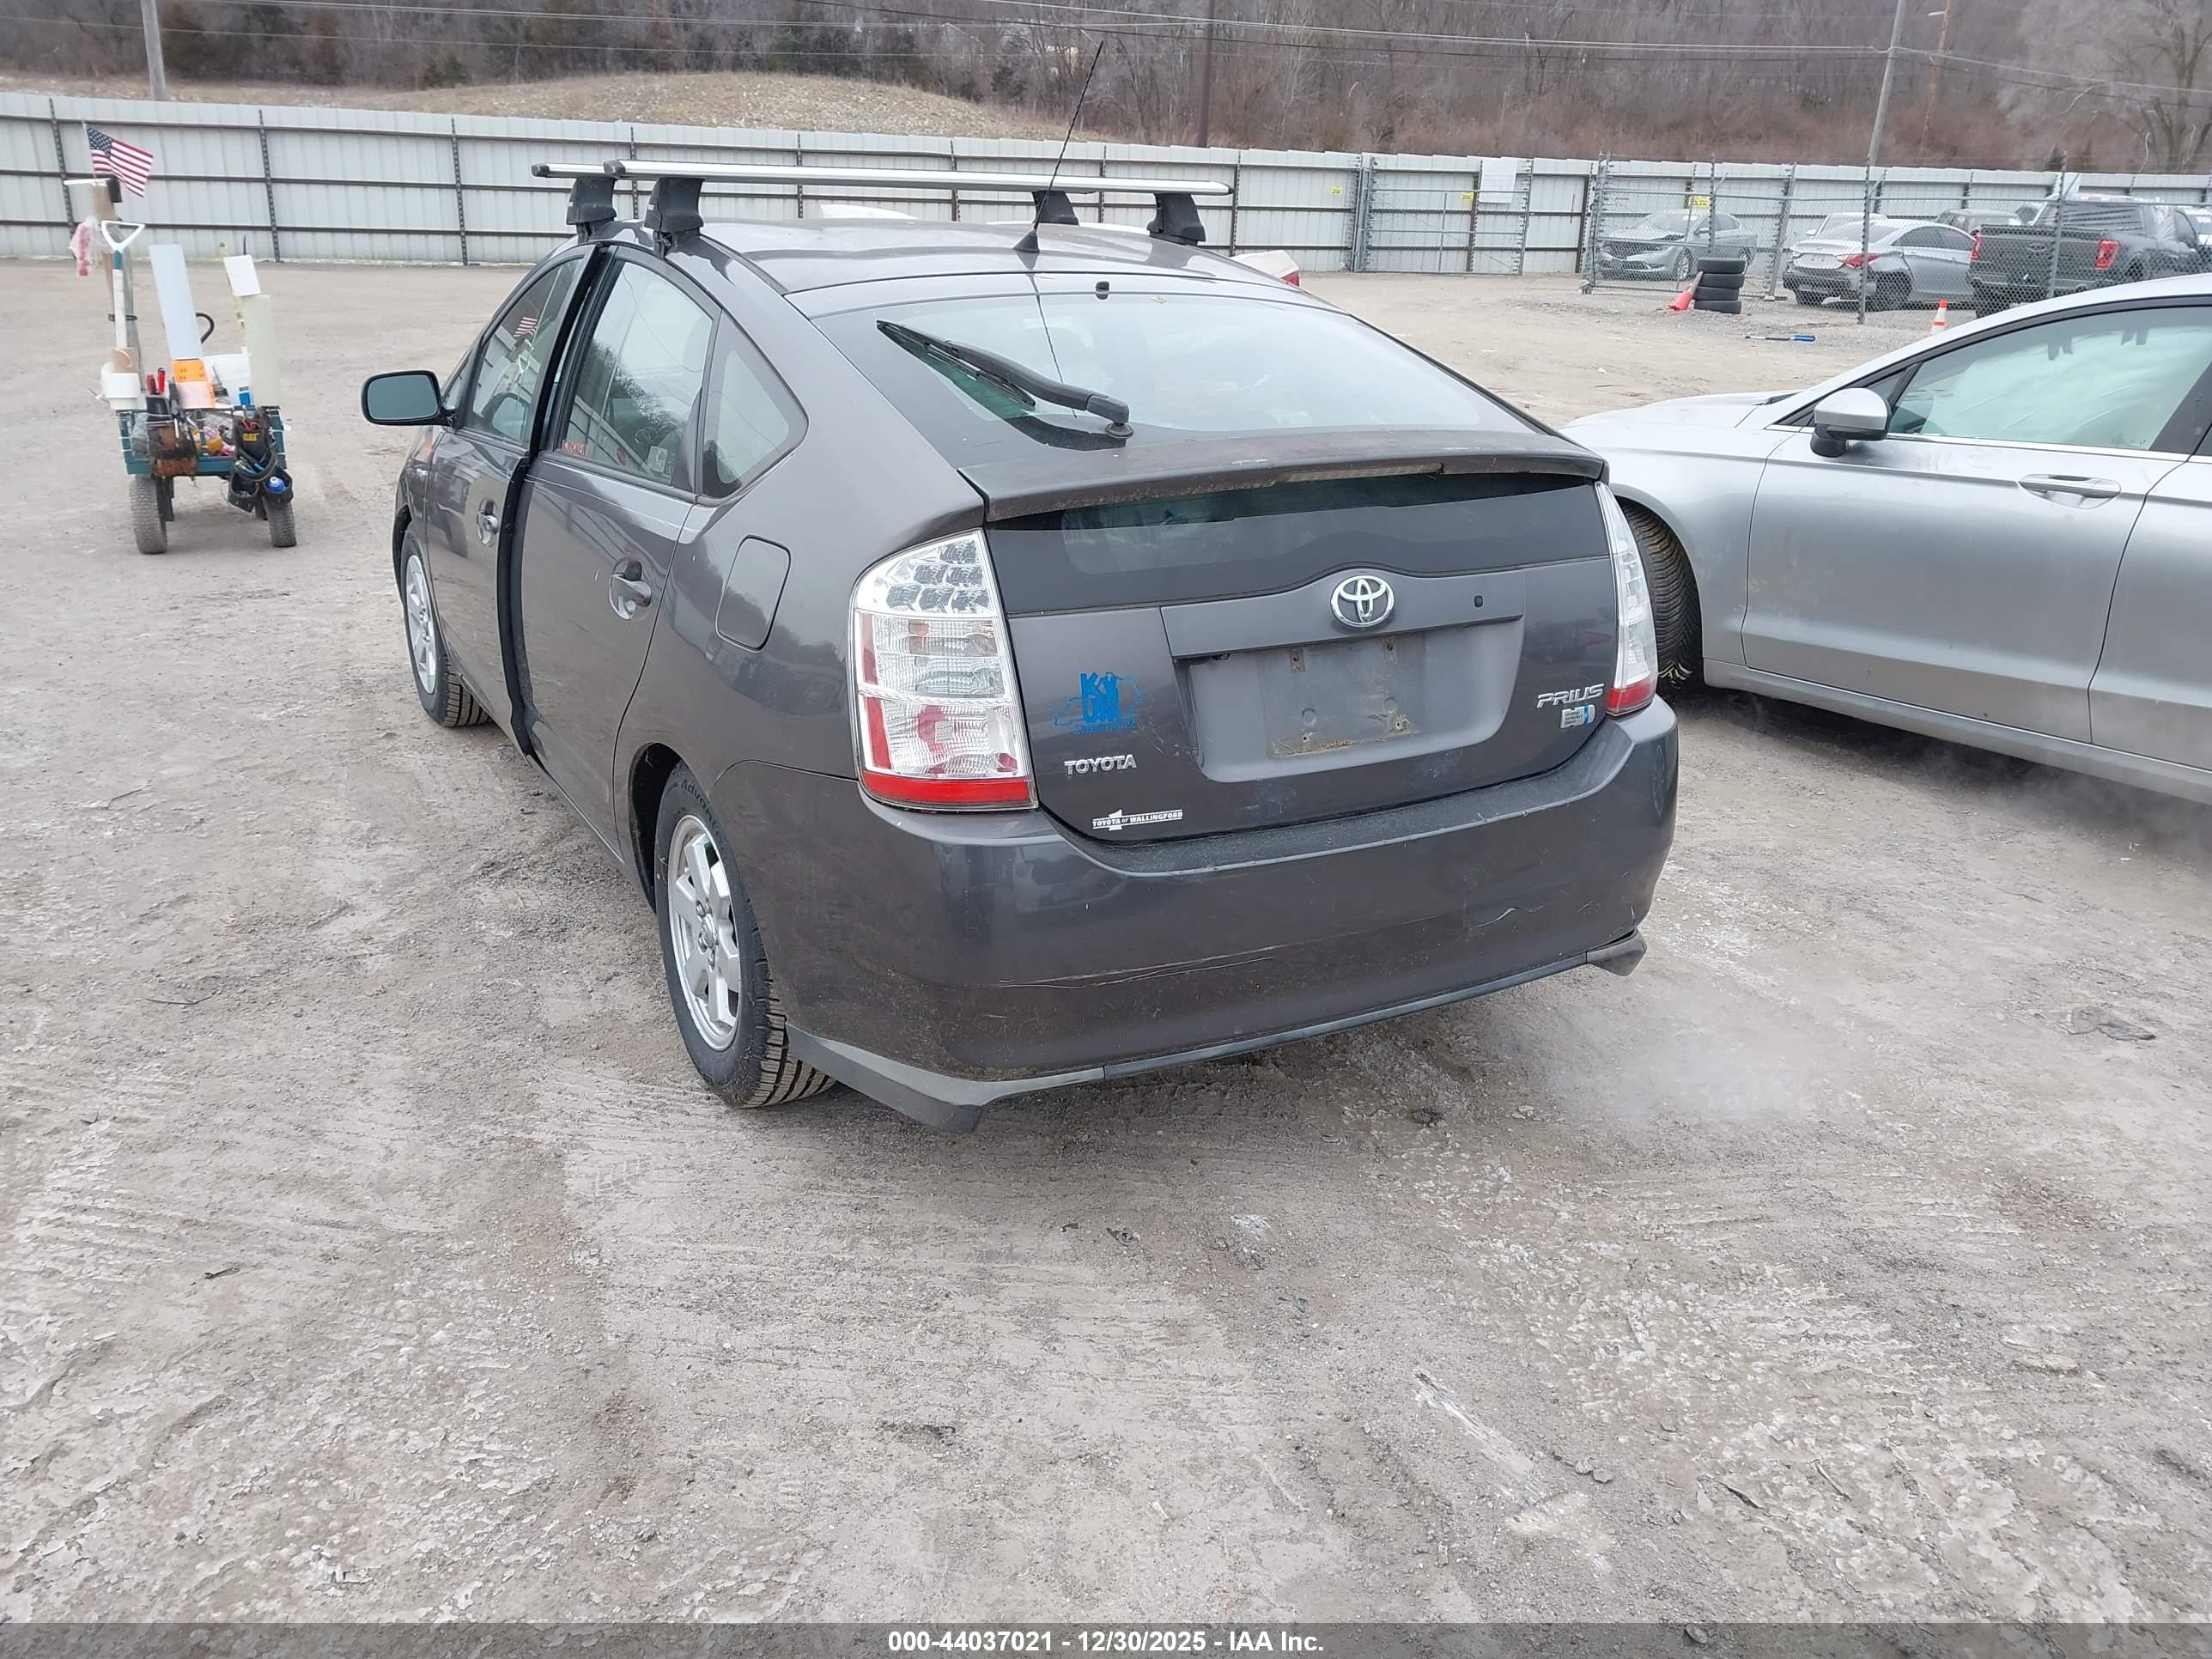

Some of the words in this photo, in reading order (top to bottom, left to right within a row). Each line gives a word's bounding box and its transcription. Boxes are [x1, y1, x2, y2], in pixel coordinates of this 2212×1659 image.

[1536, 683, 1605, 708] PRIUS
[1063, 754, 1137, 776] TOYOTA
[1092, 818, 1121, 827] TOYOTA
[1129, 811, 1183, 823] WALLINGFORD
